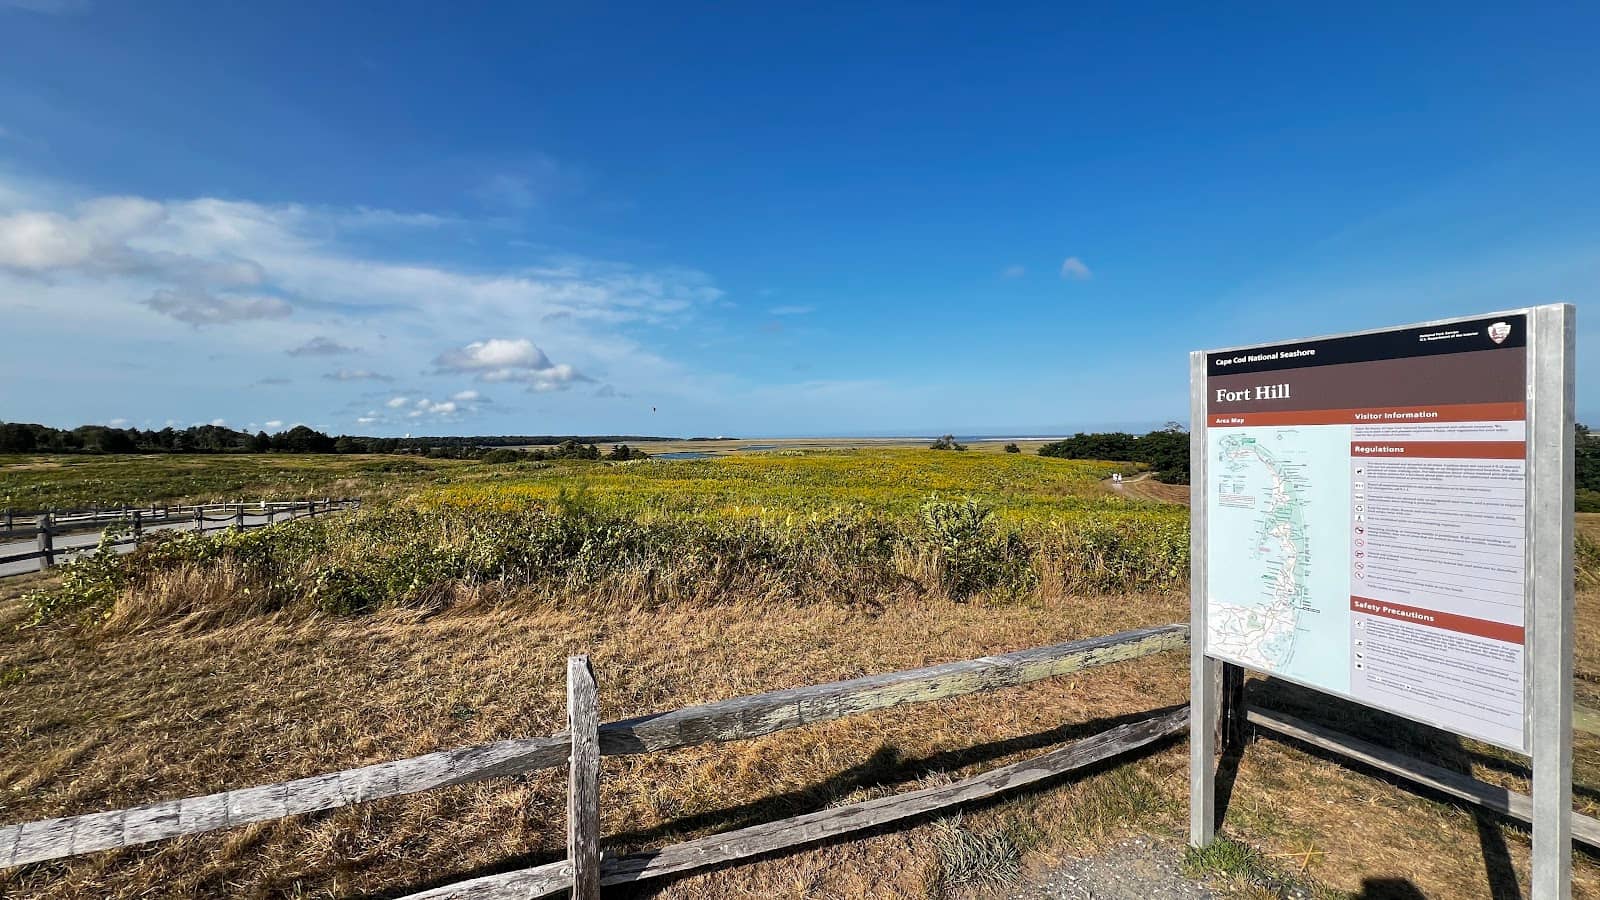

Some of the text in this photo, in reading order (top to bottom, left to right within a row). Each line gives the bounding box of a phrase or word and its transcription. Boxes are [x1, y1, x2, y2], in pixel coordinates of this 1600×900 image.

[1216, 349, 1315, 366] Cape Cod National Seashore
[1216, 383, 1290, 402] Fort Hill
[1355, 411, 1438, 420] Visitor Information
[1354, 601, 1434, 621] Safety Precautions
